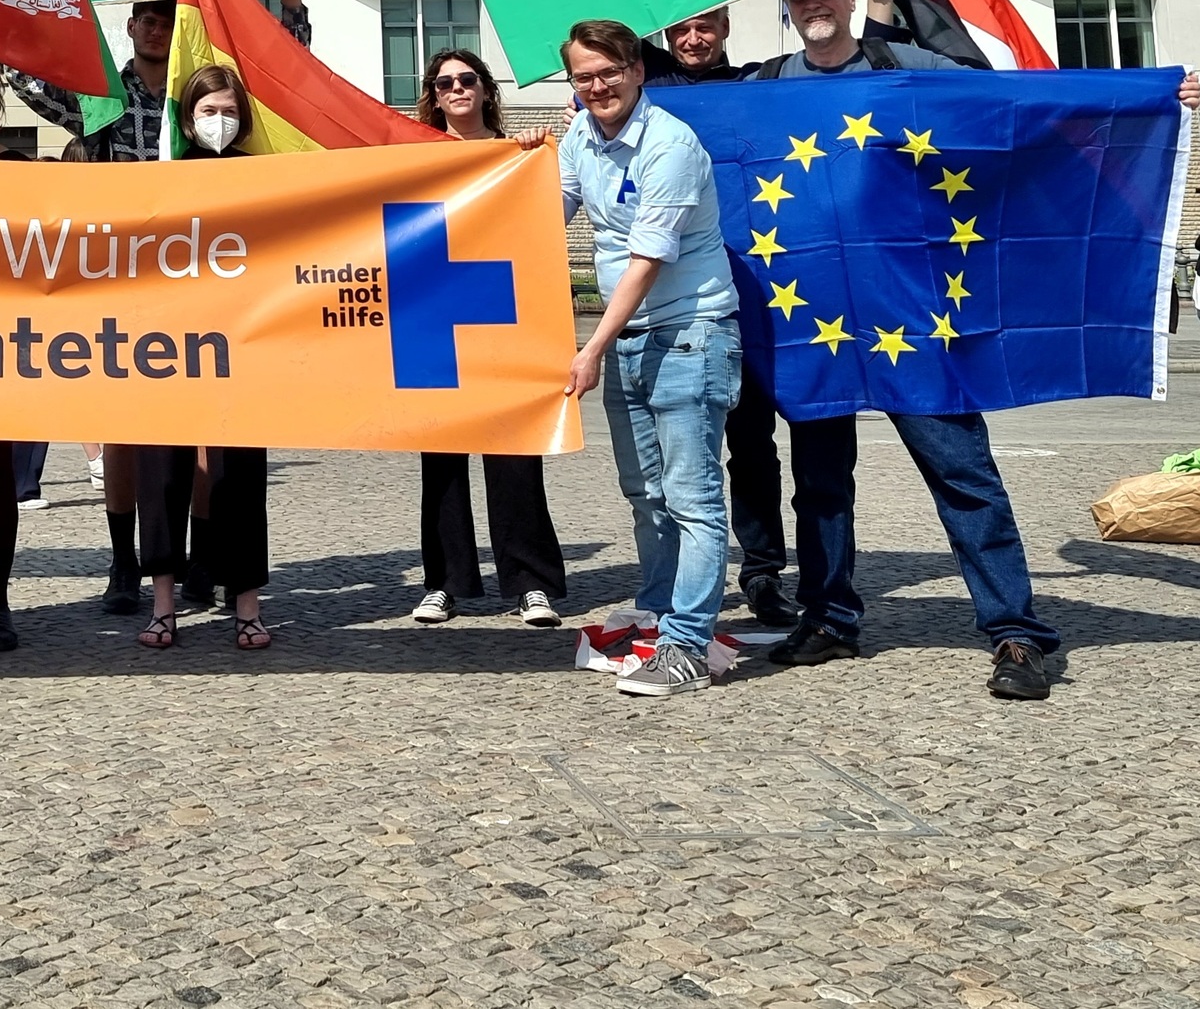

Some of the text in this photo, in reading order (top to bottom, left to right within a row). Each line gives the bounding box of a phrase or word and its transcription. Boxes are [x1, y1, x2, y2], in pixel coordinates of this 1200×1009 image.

[295, 263, 382, 285] kinder
[338, 283, 382, 304] not
[322, 306, 384, 328] hilfe
